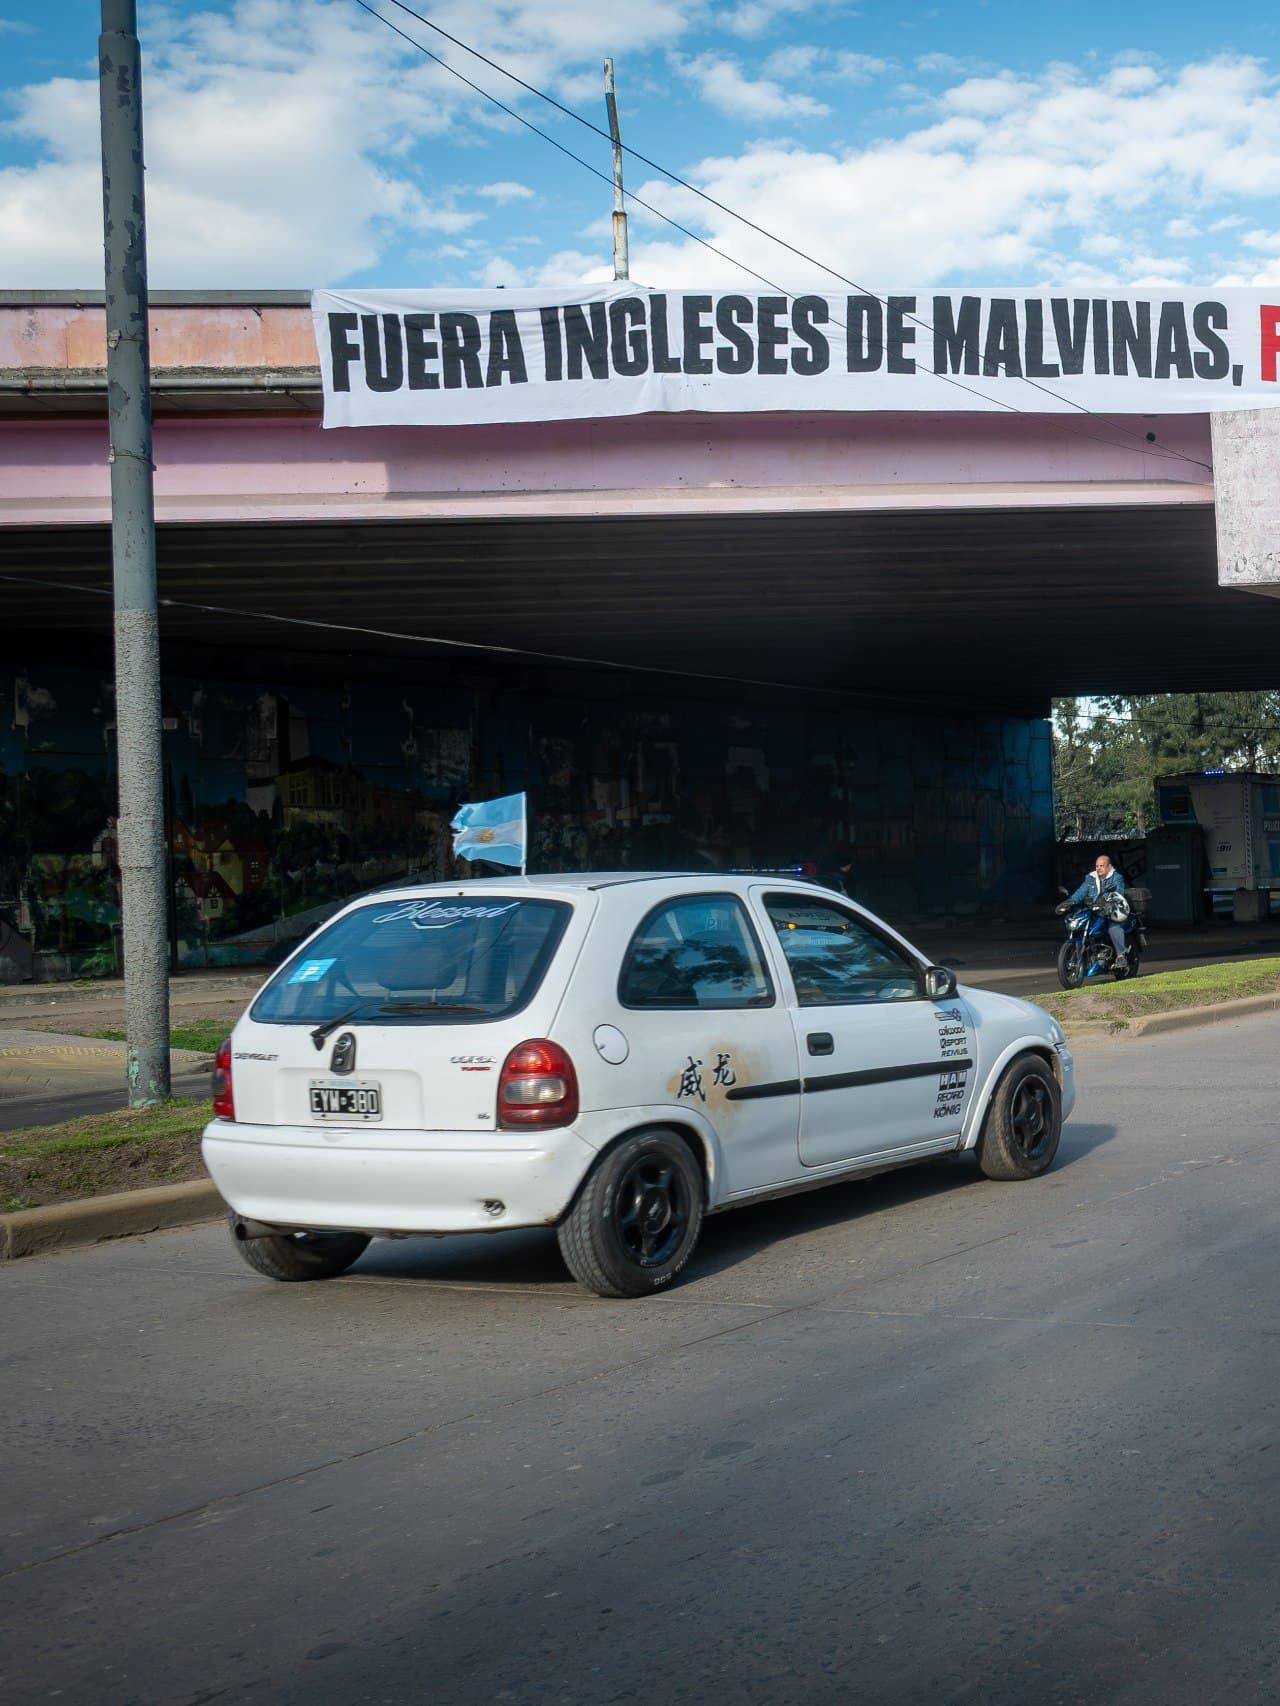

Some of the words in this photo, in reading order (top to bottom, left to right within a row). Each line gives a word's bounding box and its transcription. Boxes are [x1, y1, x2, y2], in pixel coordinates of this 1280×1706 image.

[327, 309, 528, 393] FUERA
[539, 293, 830, 382] INGLESES
[846, 295, 916, 375] DE
[932, 295, 1244, 387] MALVINAS,
[372, 900, 521, 925] Blessed
[347, 1090, 379, 1113] 380
